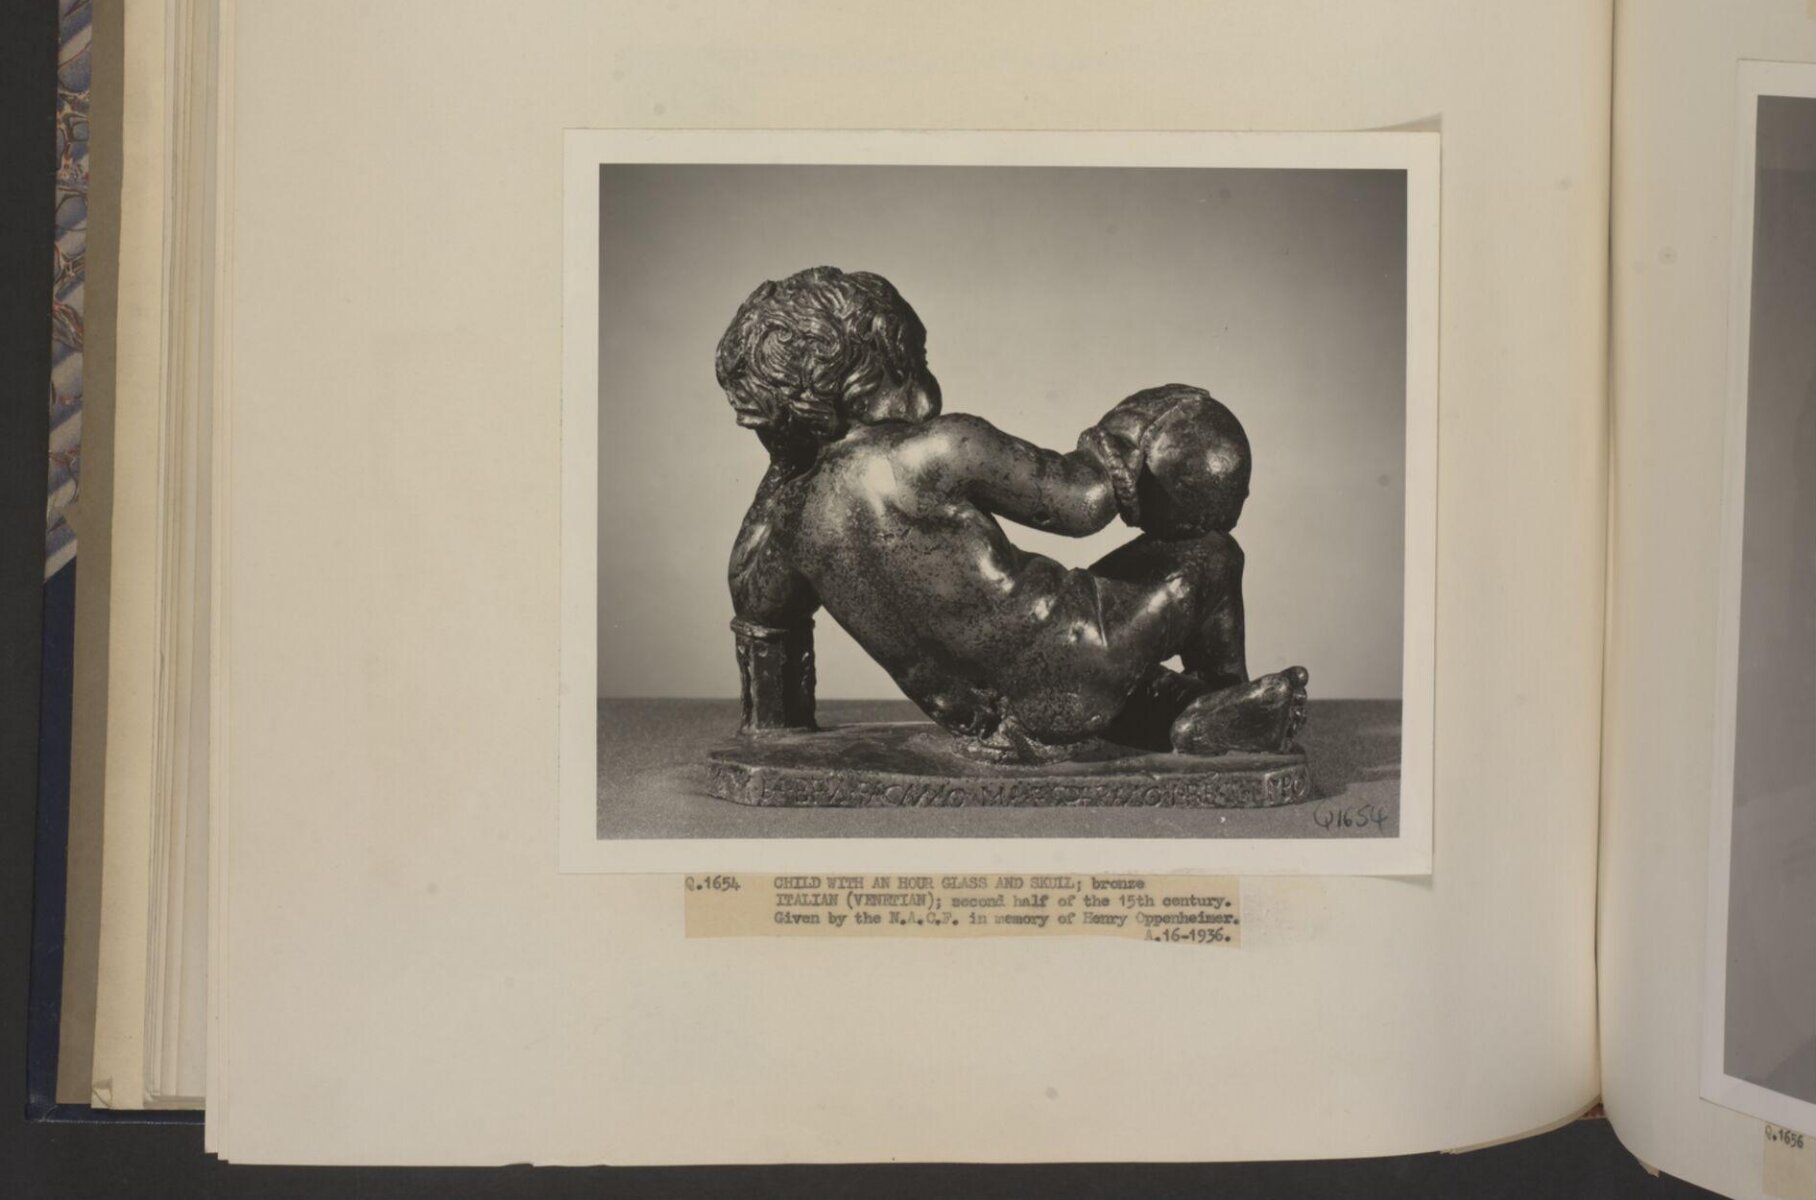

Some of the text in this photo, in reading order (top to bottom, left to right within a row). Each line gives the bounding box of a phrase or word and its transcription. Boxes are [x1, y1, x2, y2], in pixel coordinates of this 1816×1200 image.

[1313, 800, 1390, 834] Q1654
[685, 875, 741, 891] Q.1654
[773, 876, 1145, 892] CHILD WITH AN HOUR GLASS AND SKULL; bronze
[776, 891, 1232, 910] ITALIAN (VENETIAN); second half of the 15th century.
[773, 911, 1240, 927] Given by the N.A.C.F. in memory of Henry Oppenheimer.
[1144, 927, 1232, 943] A.16-1936.
[1765, 1124, 1804, 1149] Q.1656
